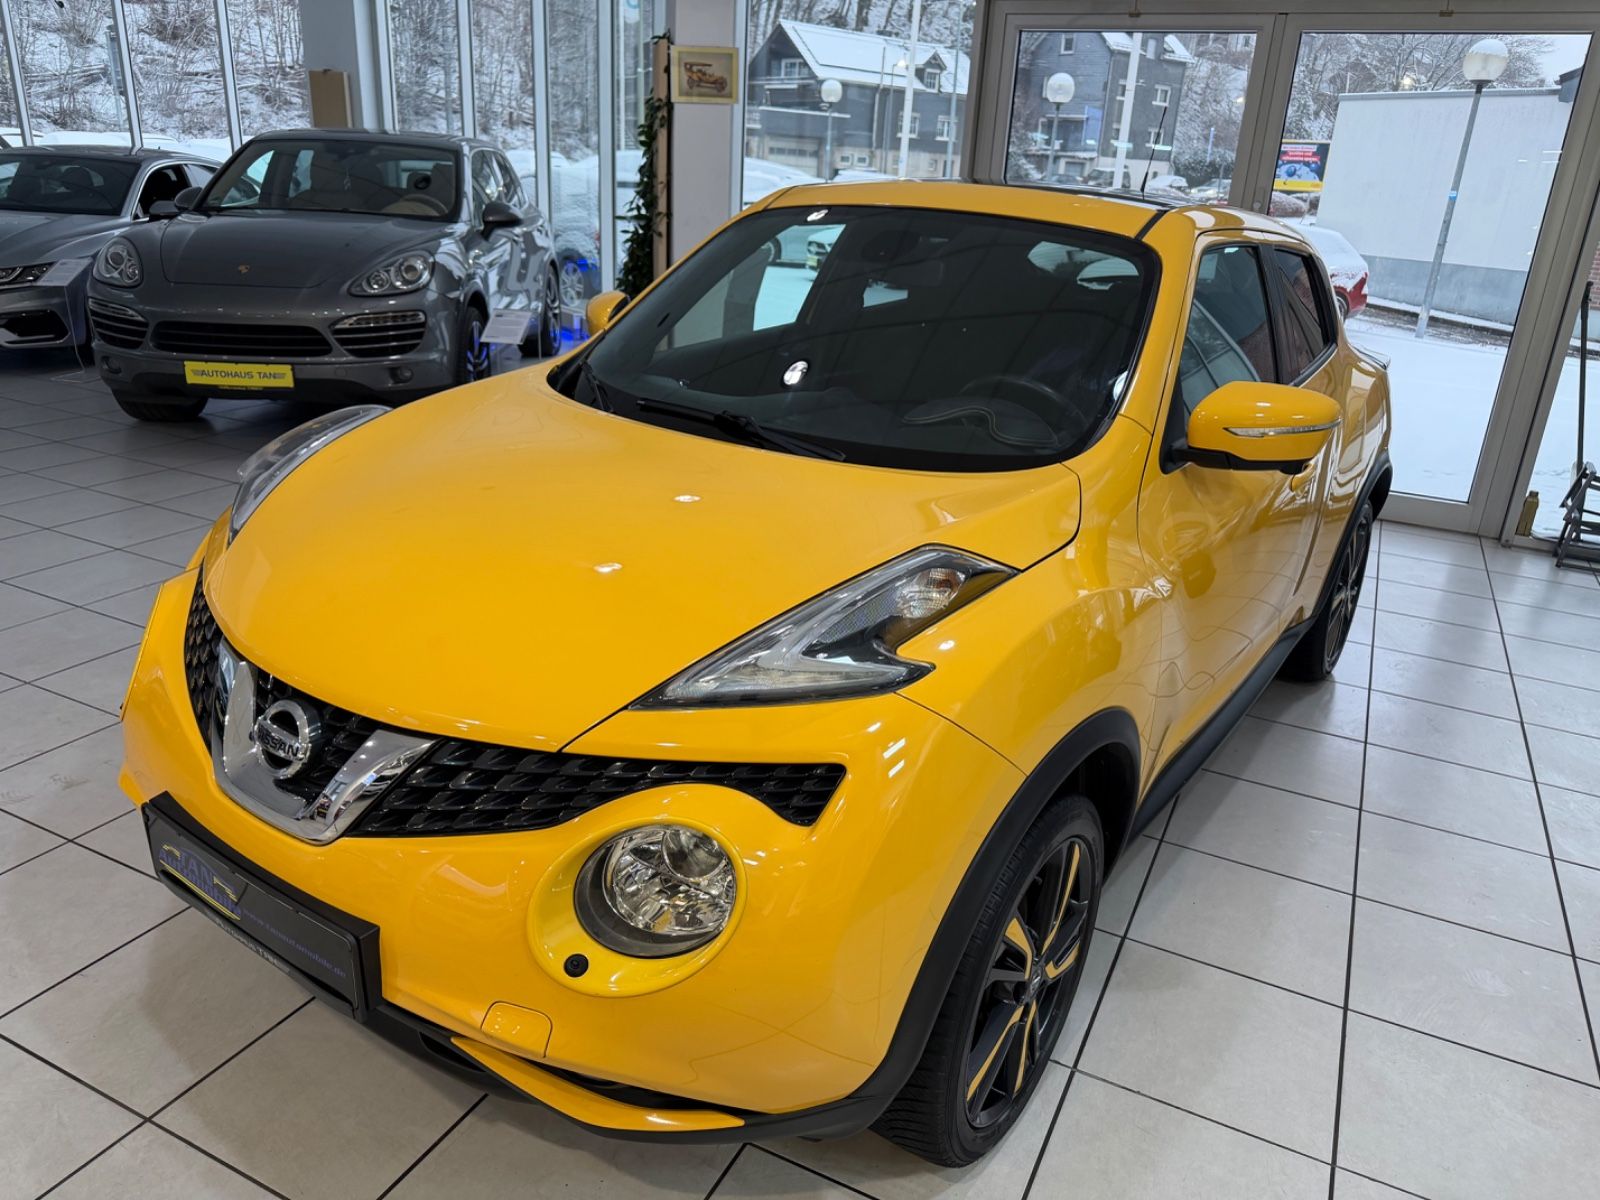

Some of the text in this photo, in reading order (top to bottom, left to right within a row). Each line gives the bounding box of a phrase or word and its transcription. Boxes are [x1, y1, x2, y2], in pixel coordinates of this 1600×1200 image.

[200, 369, 277, 380] AUTOHAUS TAN
[179, 848, 215, 887] TAN
